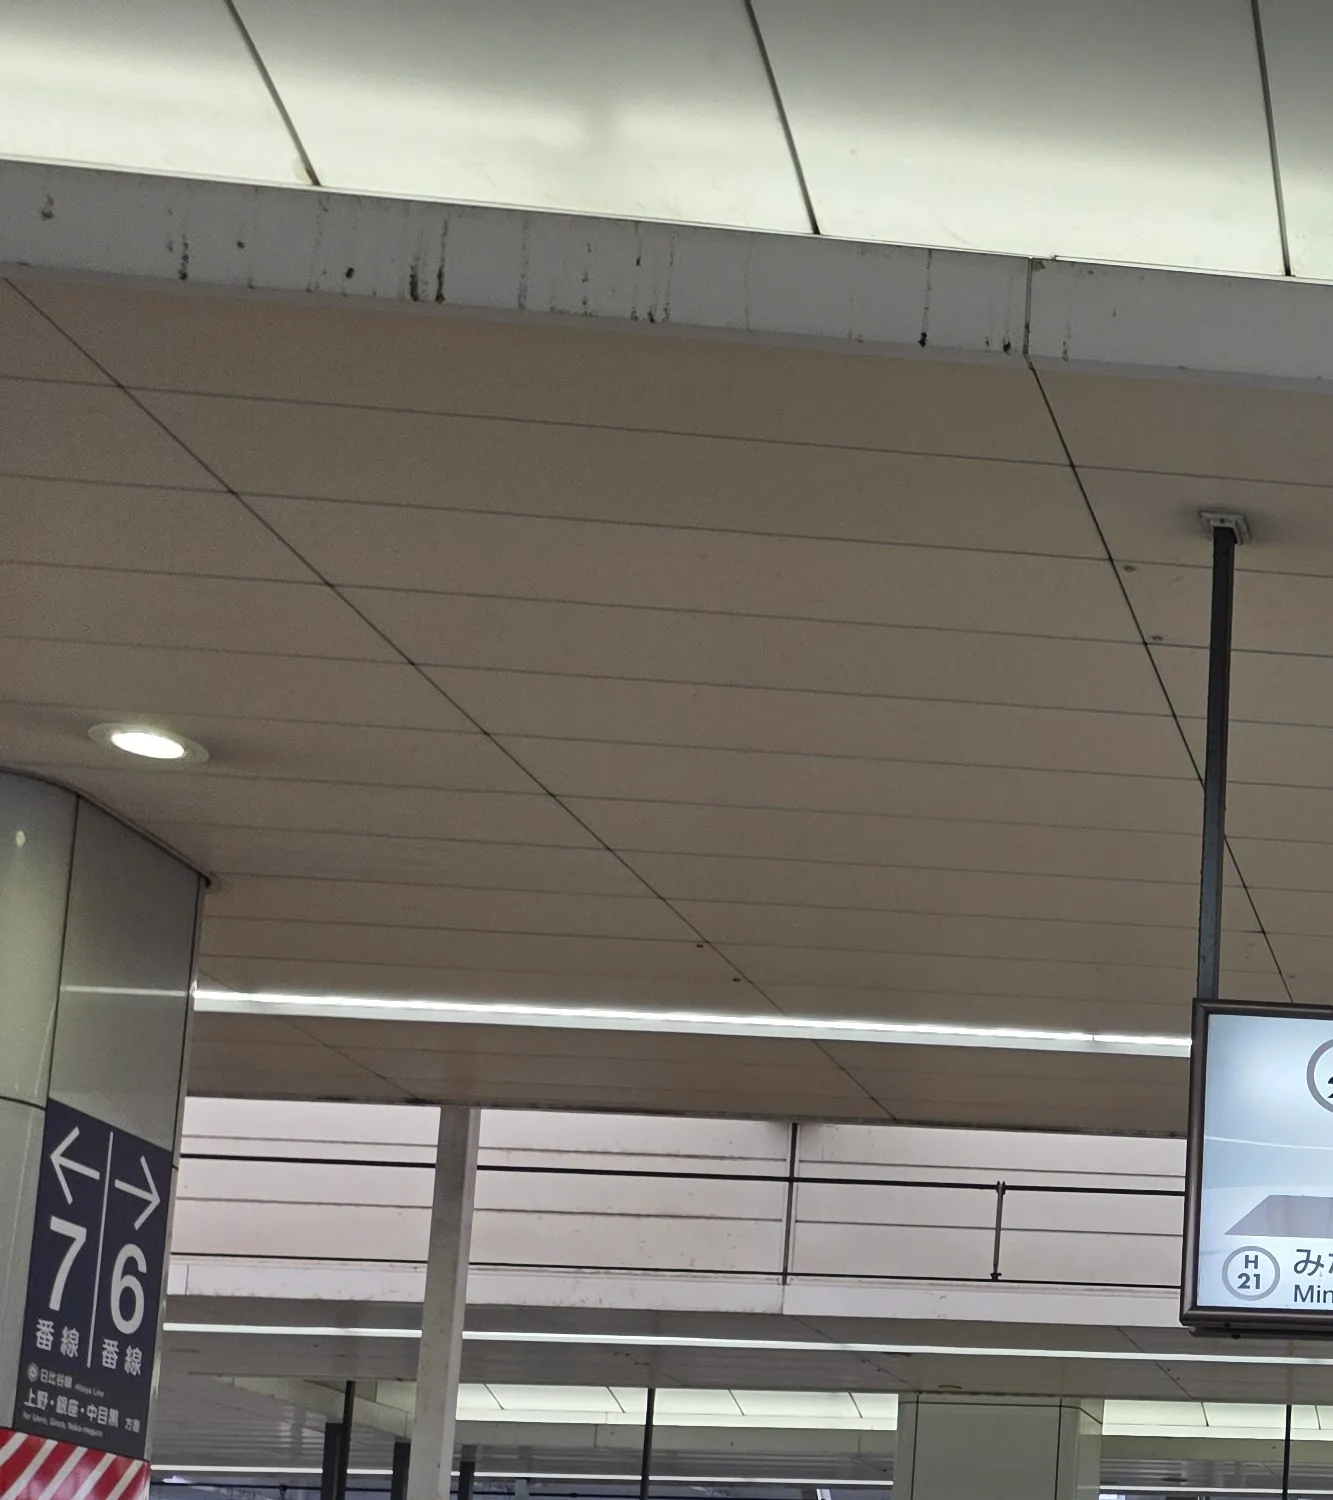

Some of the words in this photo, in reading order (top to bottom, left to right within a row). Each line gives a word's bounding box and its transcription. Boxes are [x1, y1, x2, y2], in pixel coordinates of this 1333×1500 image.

[50, 1215, 87, 1311] 7
[1237, 1273, 1261, 1289] 21
[1244, 1254, 1259, 1270] H
[110, 1243, 147, 1335] 6
[35, 1318, 80, 1359] 番線
[101, 1338, 143, 1377] 番線
